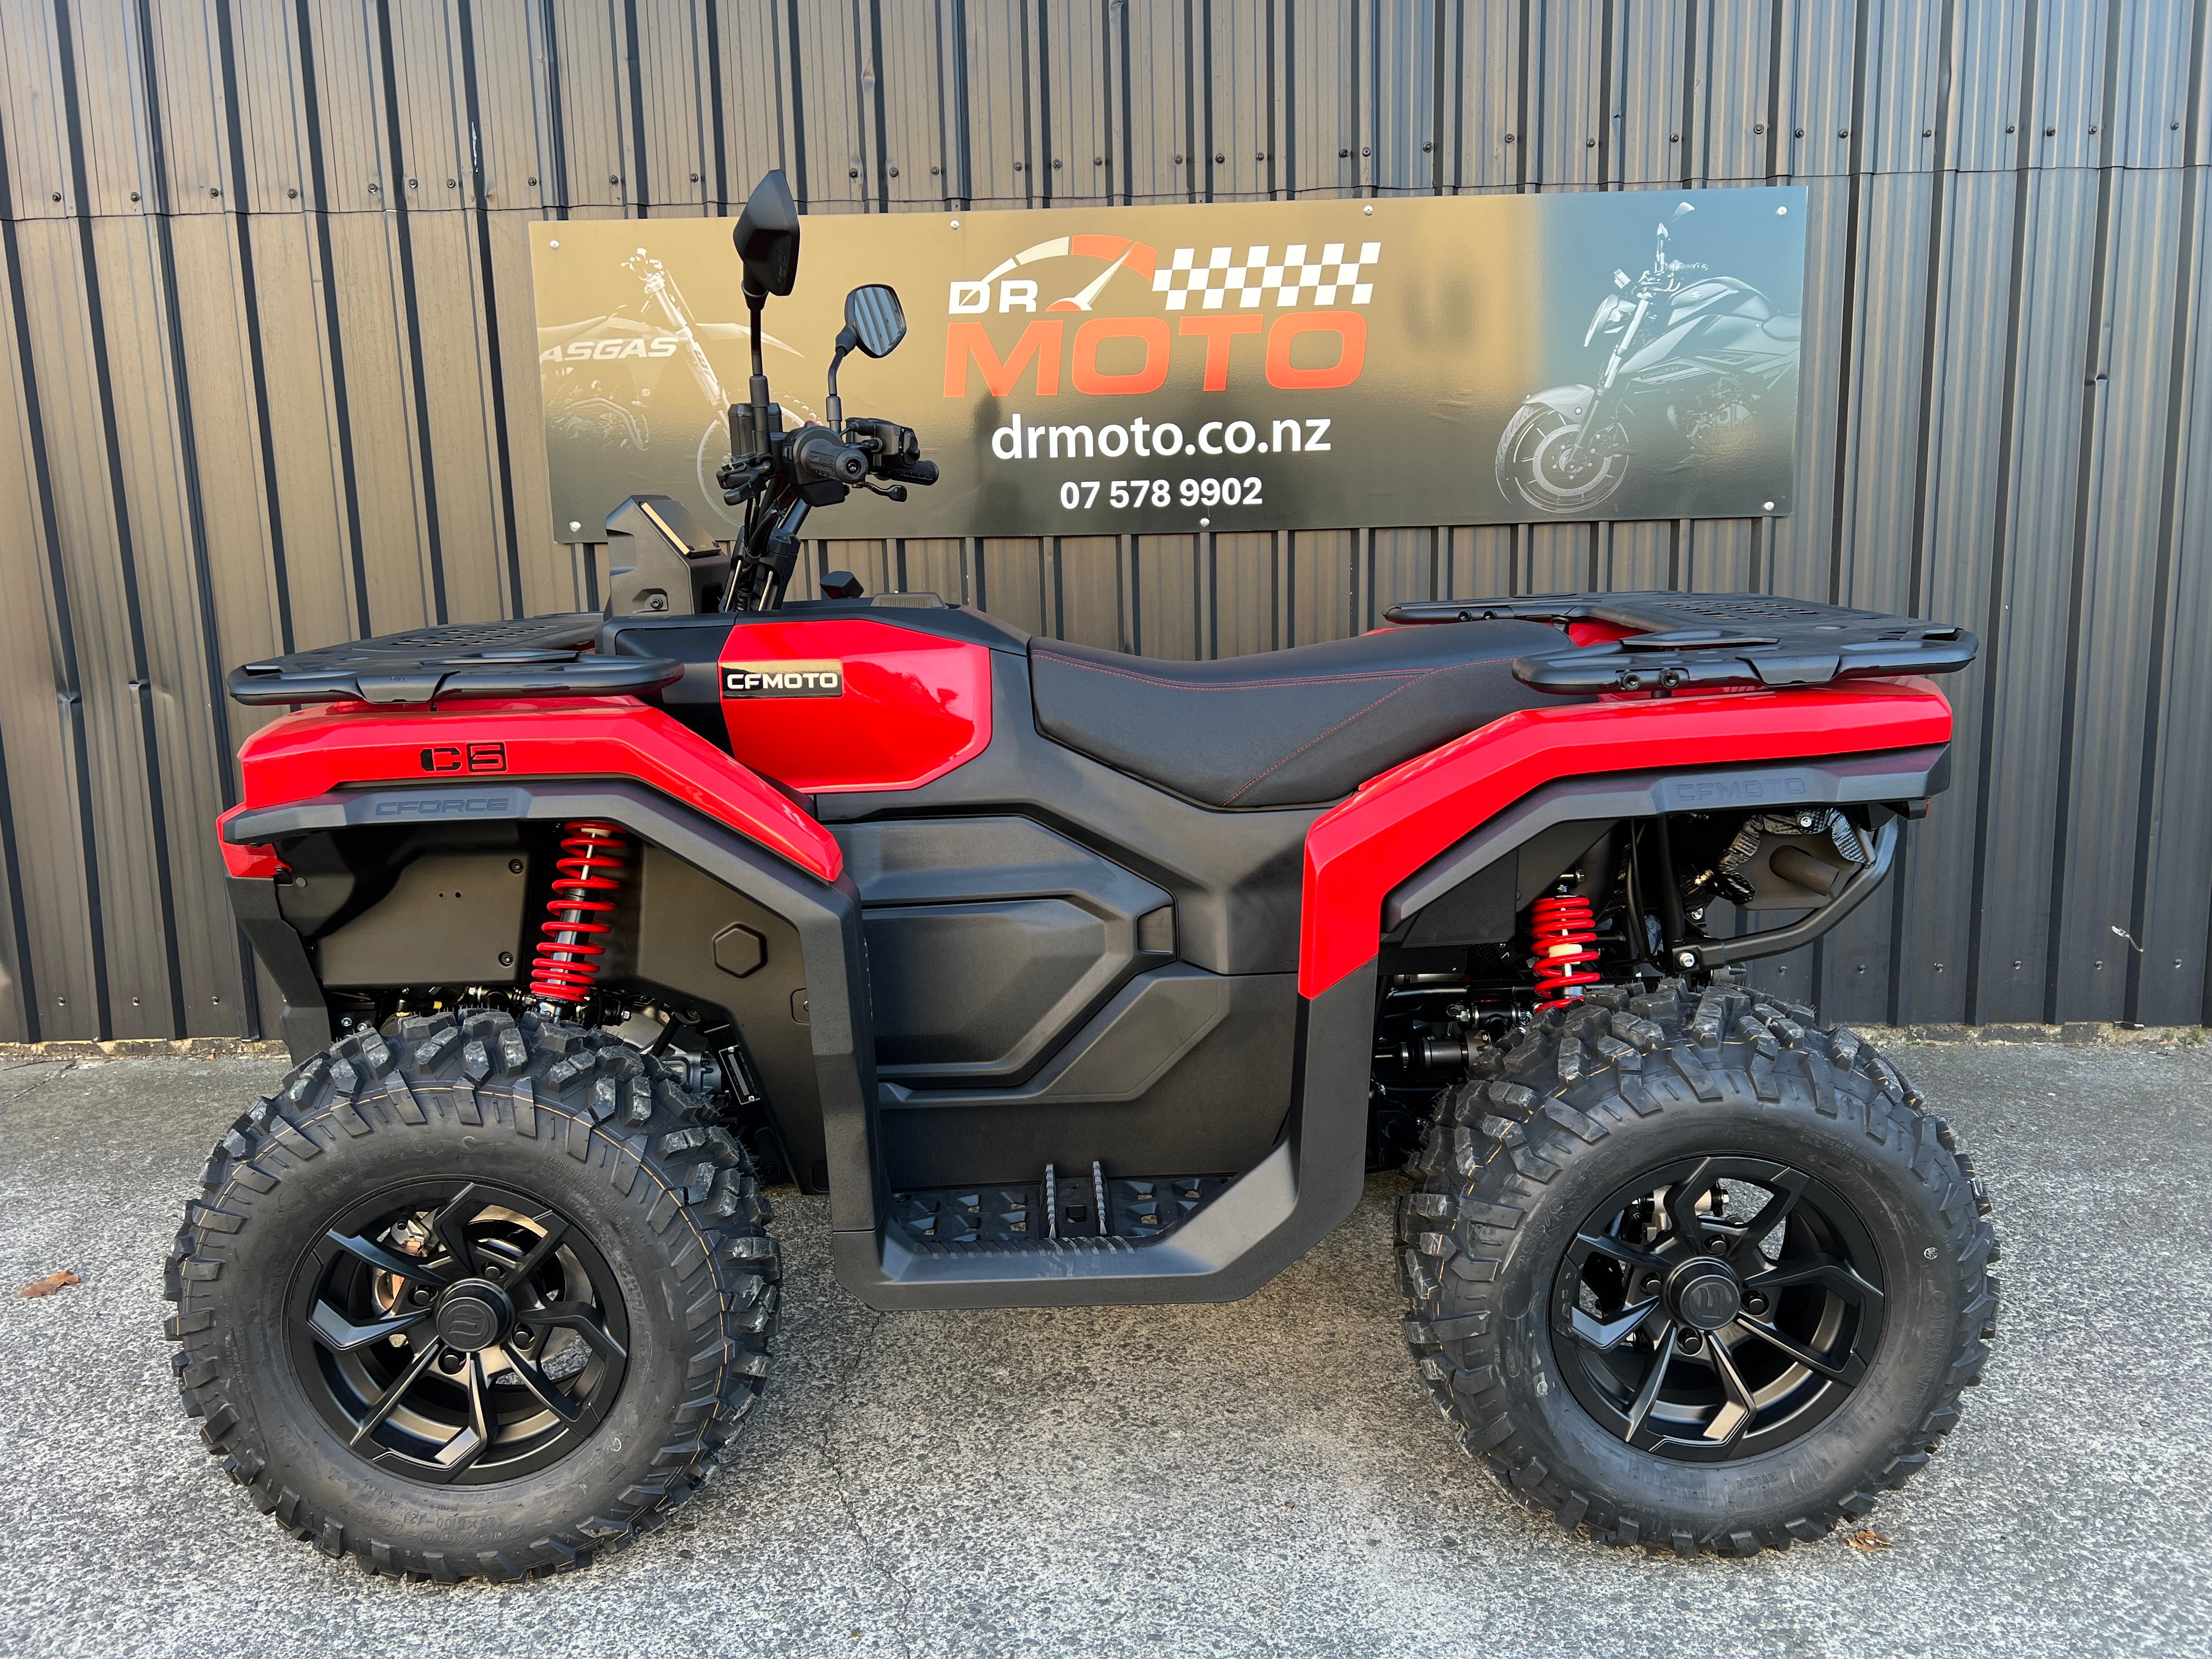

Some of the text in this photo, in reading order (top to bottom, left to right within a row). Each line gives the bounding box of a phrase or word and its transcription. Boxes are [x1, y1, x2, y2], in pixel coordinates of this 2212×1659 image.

[949, 279, 1038, 314] DR
[540, 337, 679, 363] ASGAS
[943, 311, 1368, 398] MOTO
[991, 414, 1331, 460] drmoto.co.nz
[1060, 476, 1263, 510] 07 578 9902
[727, 672, 838, 690] CFMOTO
[1675, 777, 1806, 801] CFMOTO
[375, 797, 510, 816] CFORCE
[1515, 1152, 1615, 1273] 255/65-12
